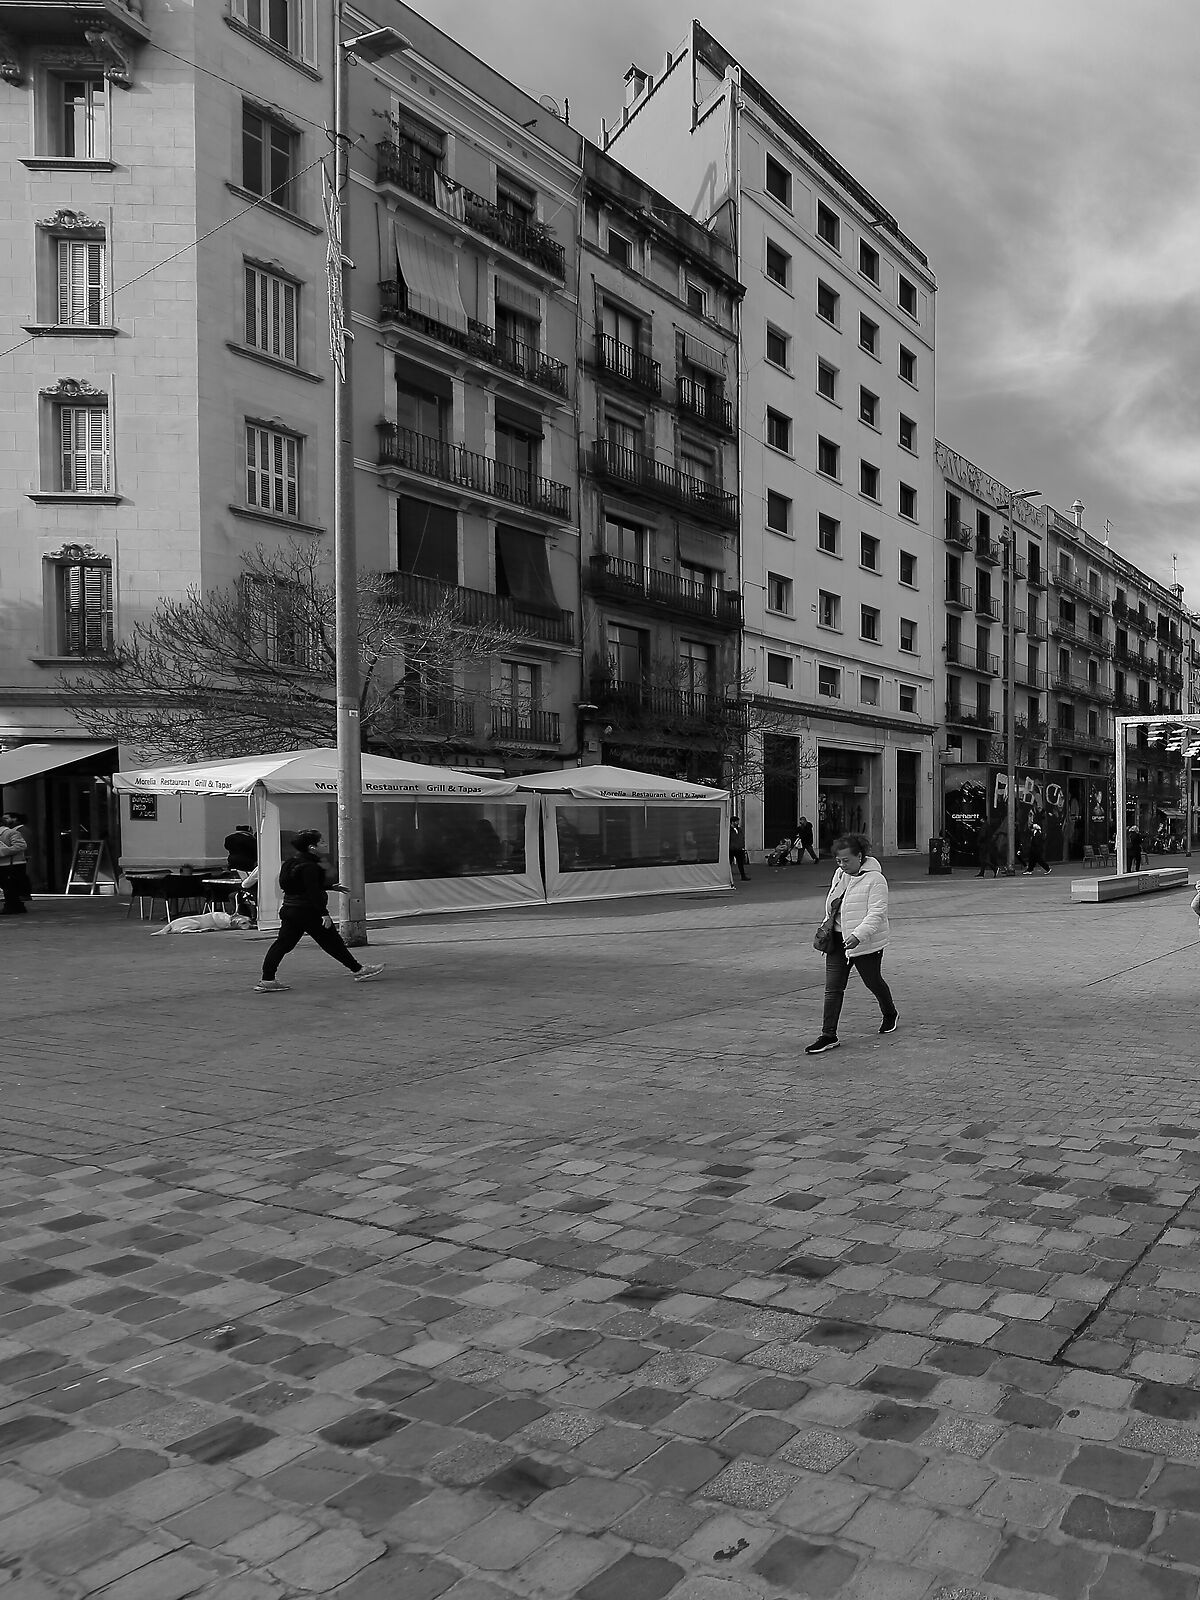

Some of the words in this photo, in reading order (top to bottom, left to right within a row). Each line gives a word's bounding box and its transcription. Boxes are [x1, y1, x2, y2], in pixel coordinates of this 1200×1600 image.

[134, 778, 156, 786] Morelia
[160, 778, 190, 787] Restaurant
[195, 779, 207, 788] Grill
[208, 780, 214, 788] &
[215, 780, 232, 790] Tapas
[365, 783, 419, 791] Restaurant
[426, 784, 445, 792] Grill
[447, 784, 456, 792] &
[458, 785, 482, 794] Tapas
